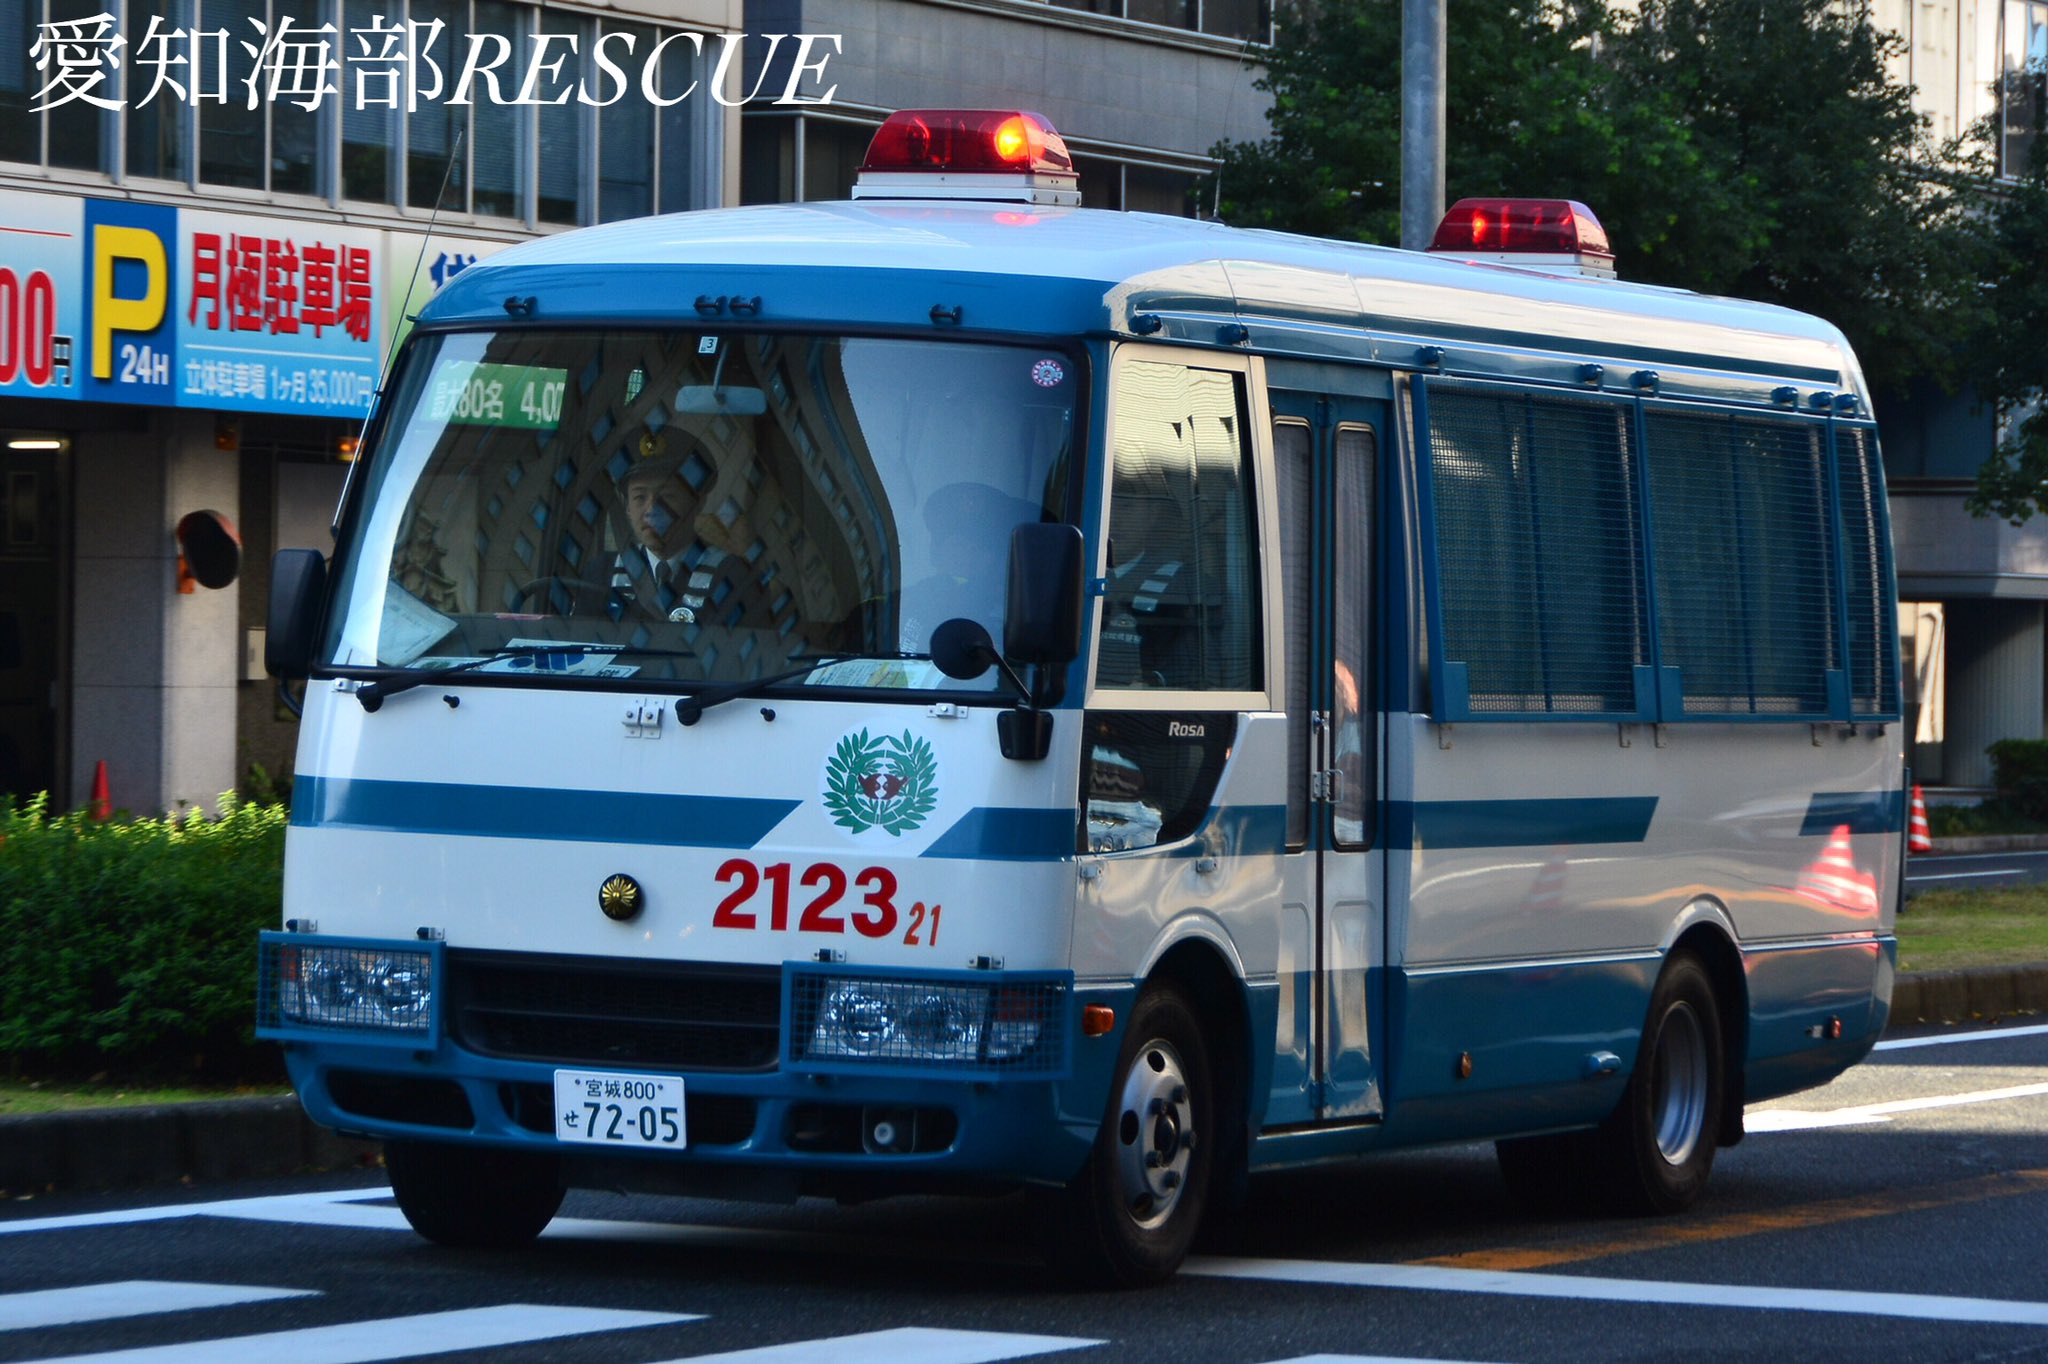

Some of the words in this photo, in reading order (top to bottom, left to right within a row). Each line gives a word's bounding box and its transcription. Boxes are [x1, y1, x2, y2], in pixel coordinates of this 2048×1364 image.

[91, 224, 168, 379] P
[188, 232, 372, 342] 月極駐車場
[119, 343, 169, 385] 24H
[184, 358, 266, 400] 立体駐車場
[712, 858, 898, 938] 2123
[903, 901, 942, 947] 21
[585, 1079, 656, 1101] 宮城800
[563, 1109, 579, 1128] せ
[583, 1101, 679, 1143] 72-05
